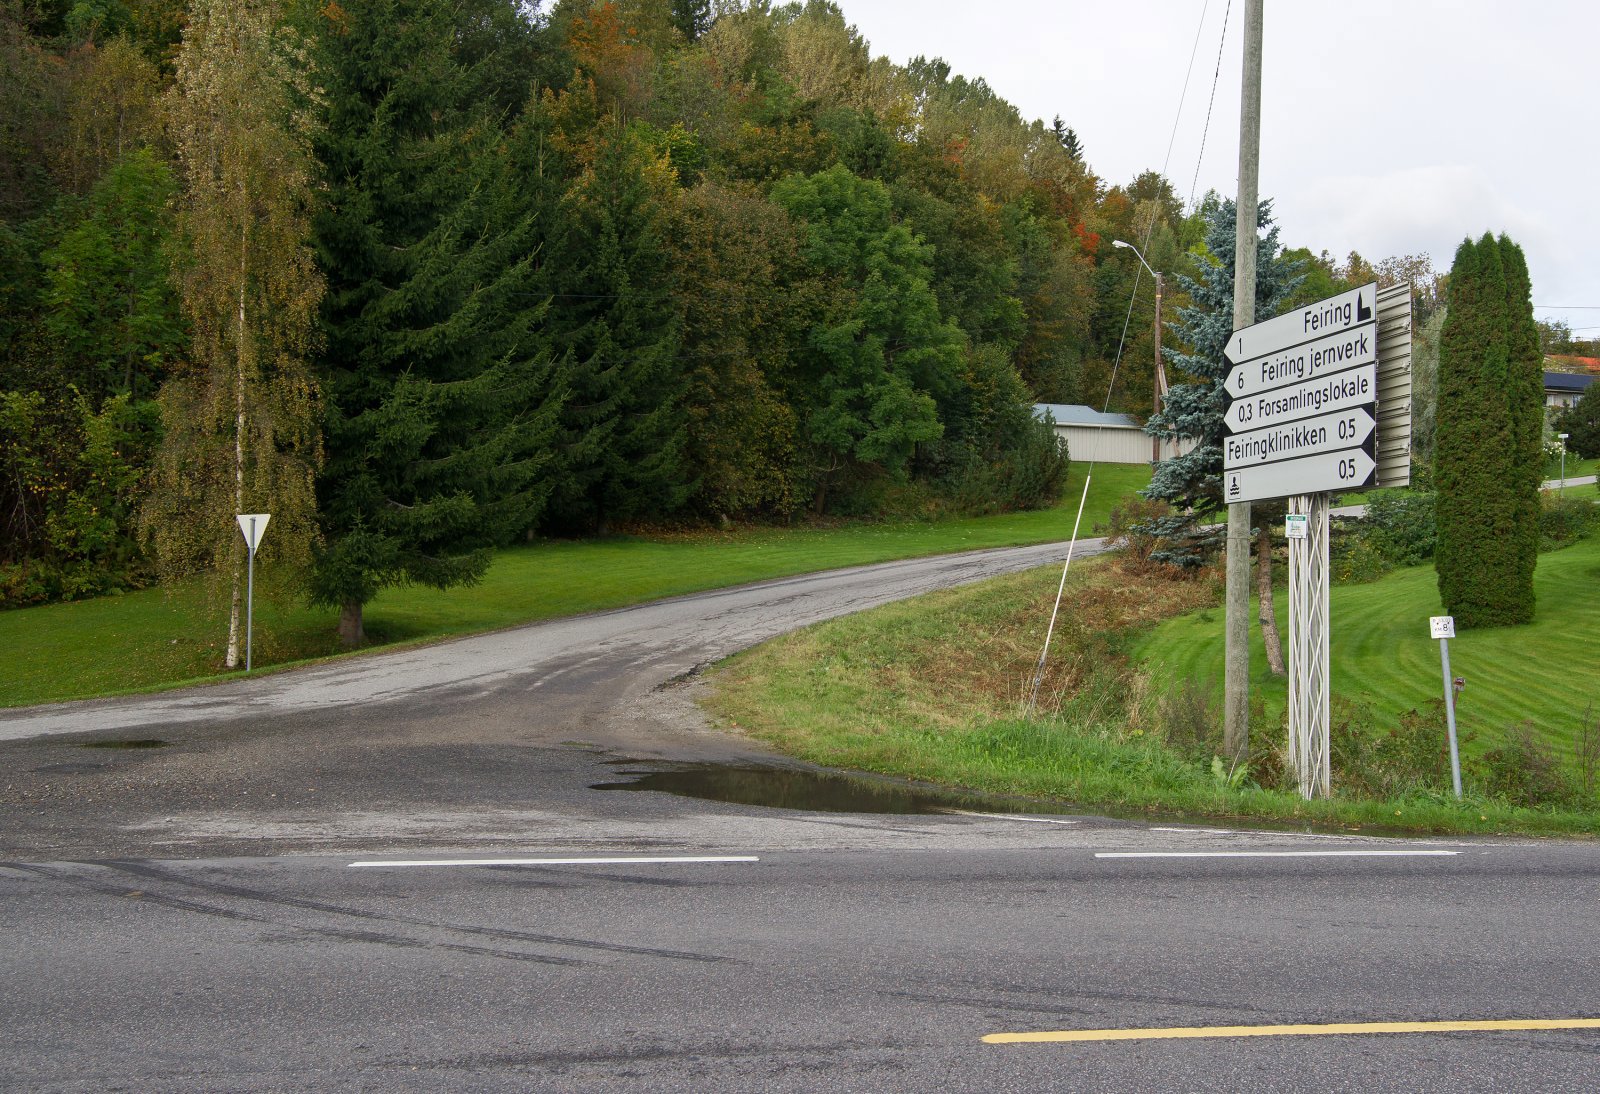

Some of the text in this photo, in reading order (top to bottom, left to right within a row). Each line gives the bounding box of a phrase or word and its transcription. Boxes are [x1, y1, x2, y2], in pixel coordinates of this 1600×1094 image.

[1238, 302, 1351, 354] 1 Feiring
[1238, 333, 1368, 389] 6 Feiring jernverk
[1239, 375, 1368, 423] 0,3 Forsamlingslokale
[1228, 418, 1355, 460] Feiringklinikken 0,5
[1339, 459, 1355, 479] 0,5
